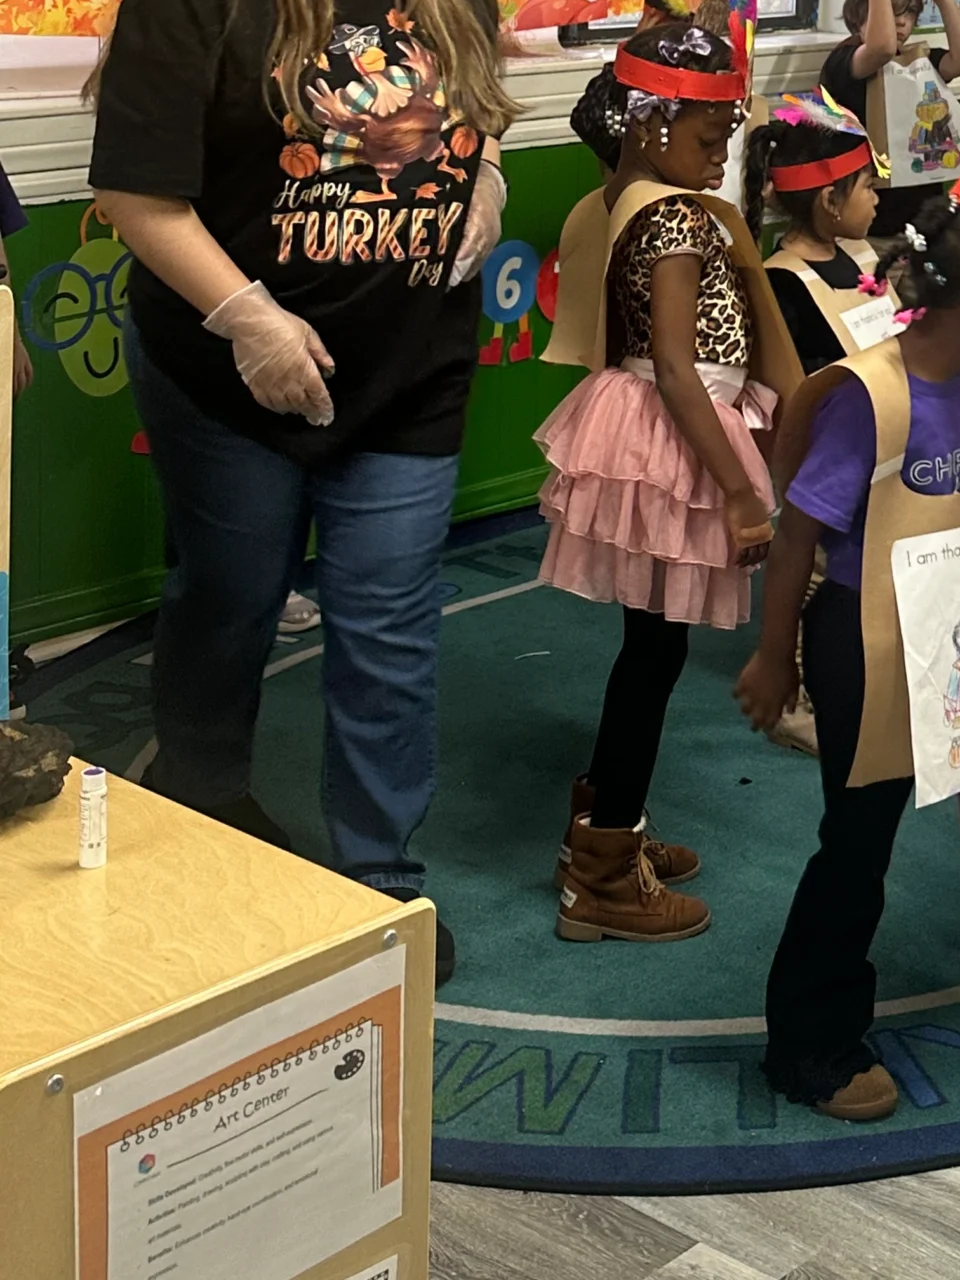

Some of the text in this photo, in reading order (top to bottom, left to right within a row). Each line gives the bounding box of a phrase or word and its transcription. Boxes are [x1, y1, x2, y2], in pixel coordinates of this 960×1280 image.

[272, 178, 352, 210] Happy
[270, 201, 464, 266] TURKEY
[407, 258, 444, 288] Day
[495, 256, 523, 310] 6
[917, 551, 938, 565] am
[213, 1086, 290, 1133] Art Center
